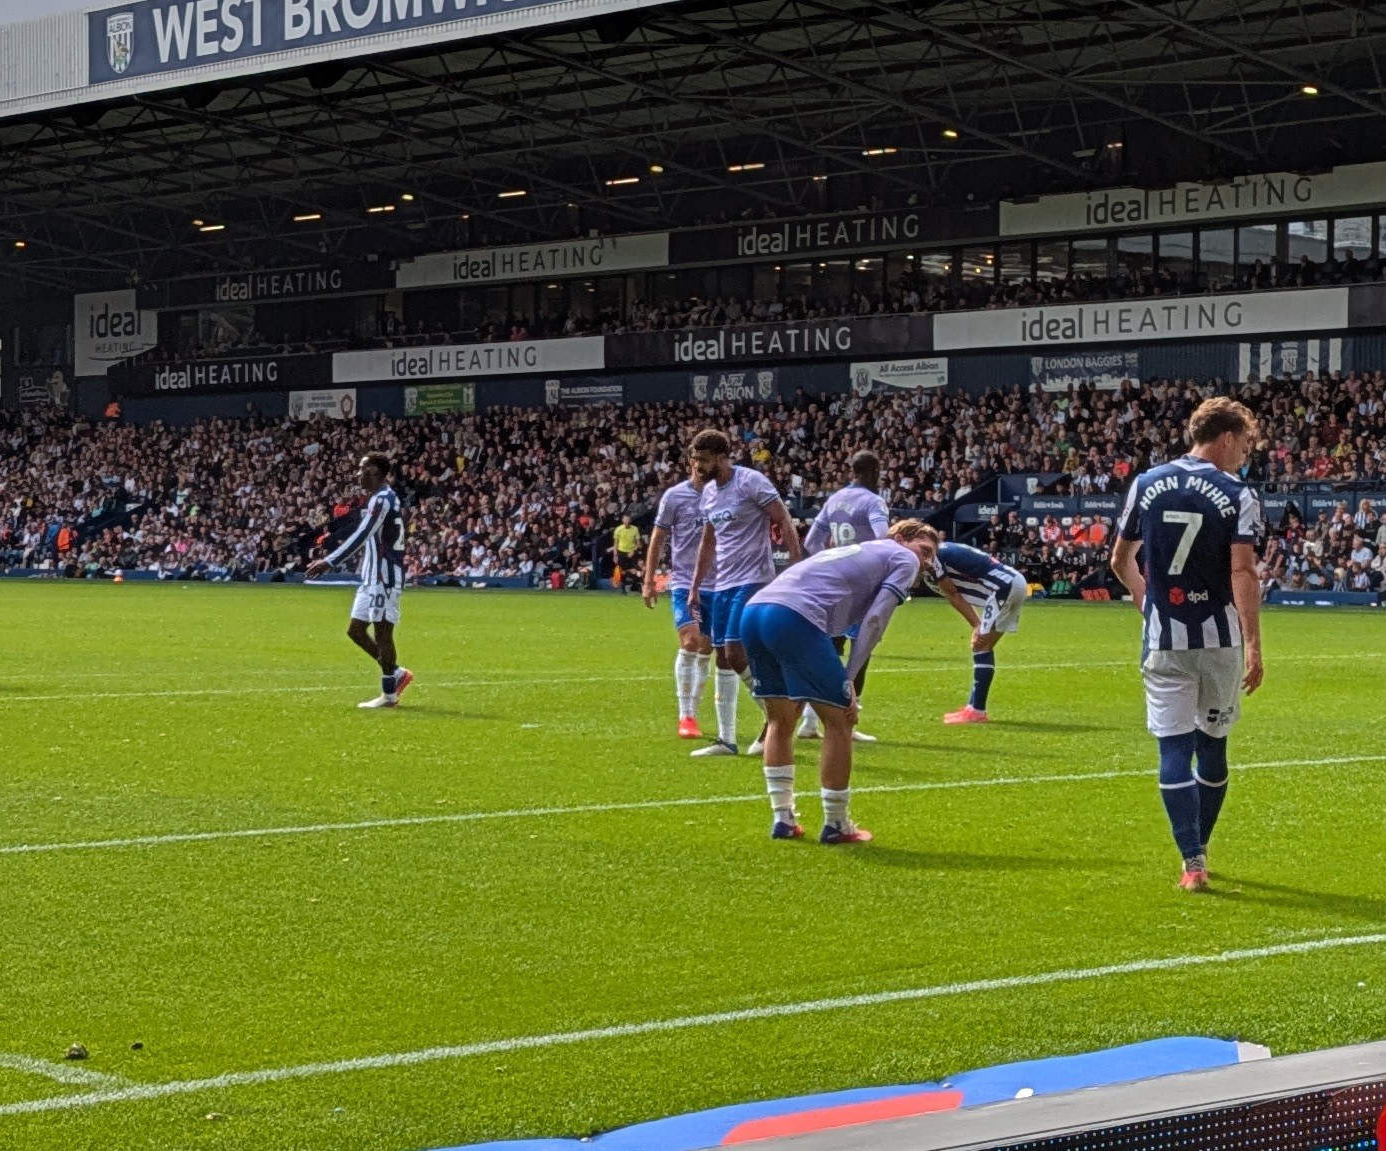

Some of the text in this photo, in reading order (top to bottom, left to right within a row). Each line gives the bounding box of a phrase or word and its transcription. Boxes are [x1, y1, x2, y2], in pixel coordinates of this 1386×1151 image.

[1086, 177, 1311, 225] ideal HEATING
[737, 215, 919, 256] ideal HEATING
[453, 245, 602, 280] ideal HEATING
[216, 269, 342, 301] ideal HEATING
[90, 303, 141, 339] ideal
[1022, 302, 1242, 342] ideal HEATING
[391, 346, 536, 376] ideal HEATING
[674, 327, 851, 362] ideal HEATING
[1045, 355, 1122, 369] LONDON BAGGIES
[155, 362, 278, 390] ideal HEATING
[891, 364, 914, 372] Access
[916, 362, 939, 371] Albion
[1140, 476, 1237, 518] HORN MYHRE
[1163, 510, 1203, 575] 7
[984, 605, 993, 619] 8
[1187, 589, 1209, 604] dpd
